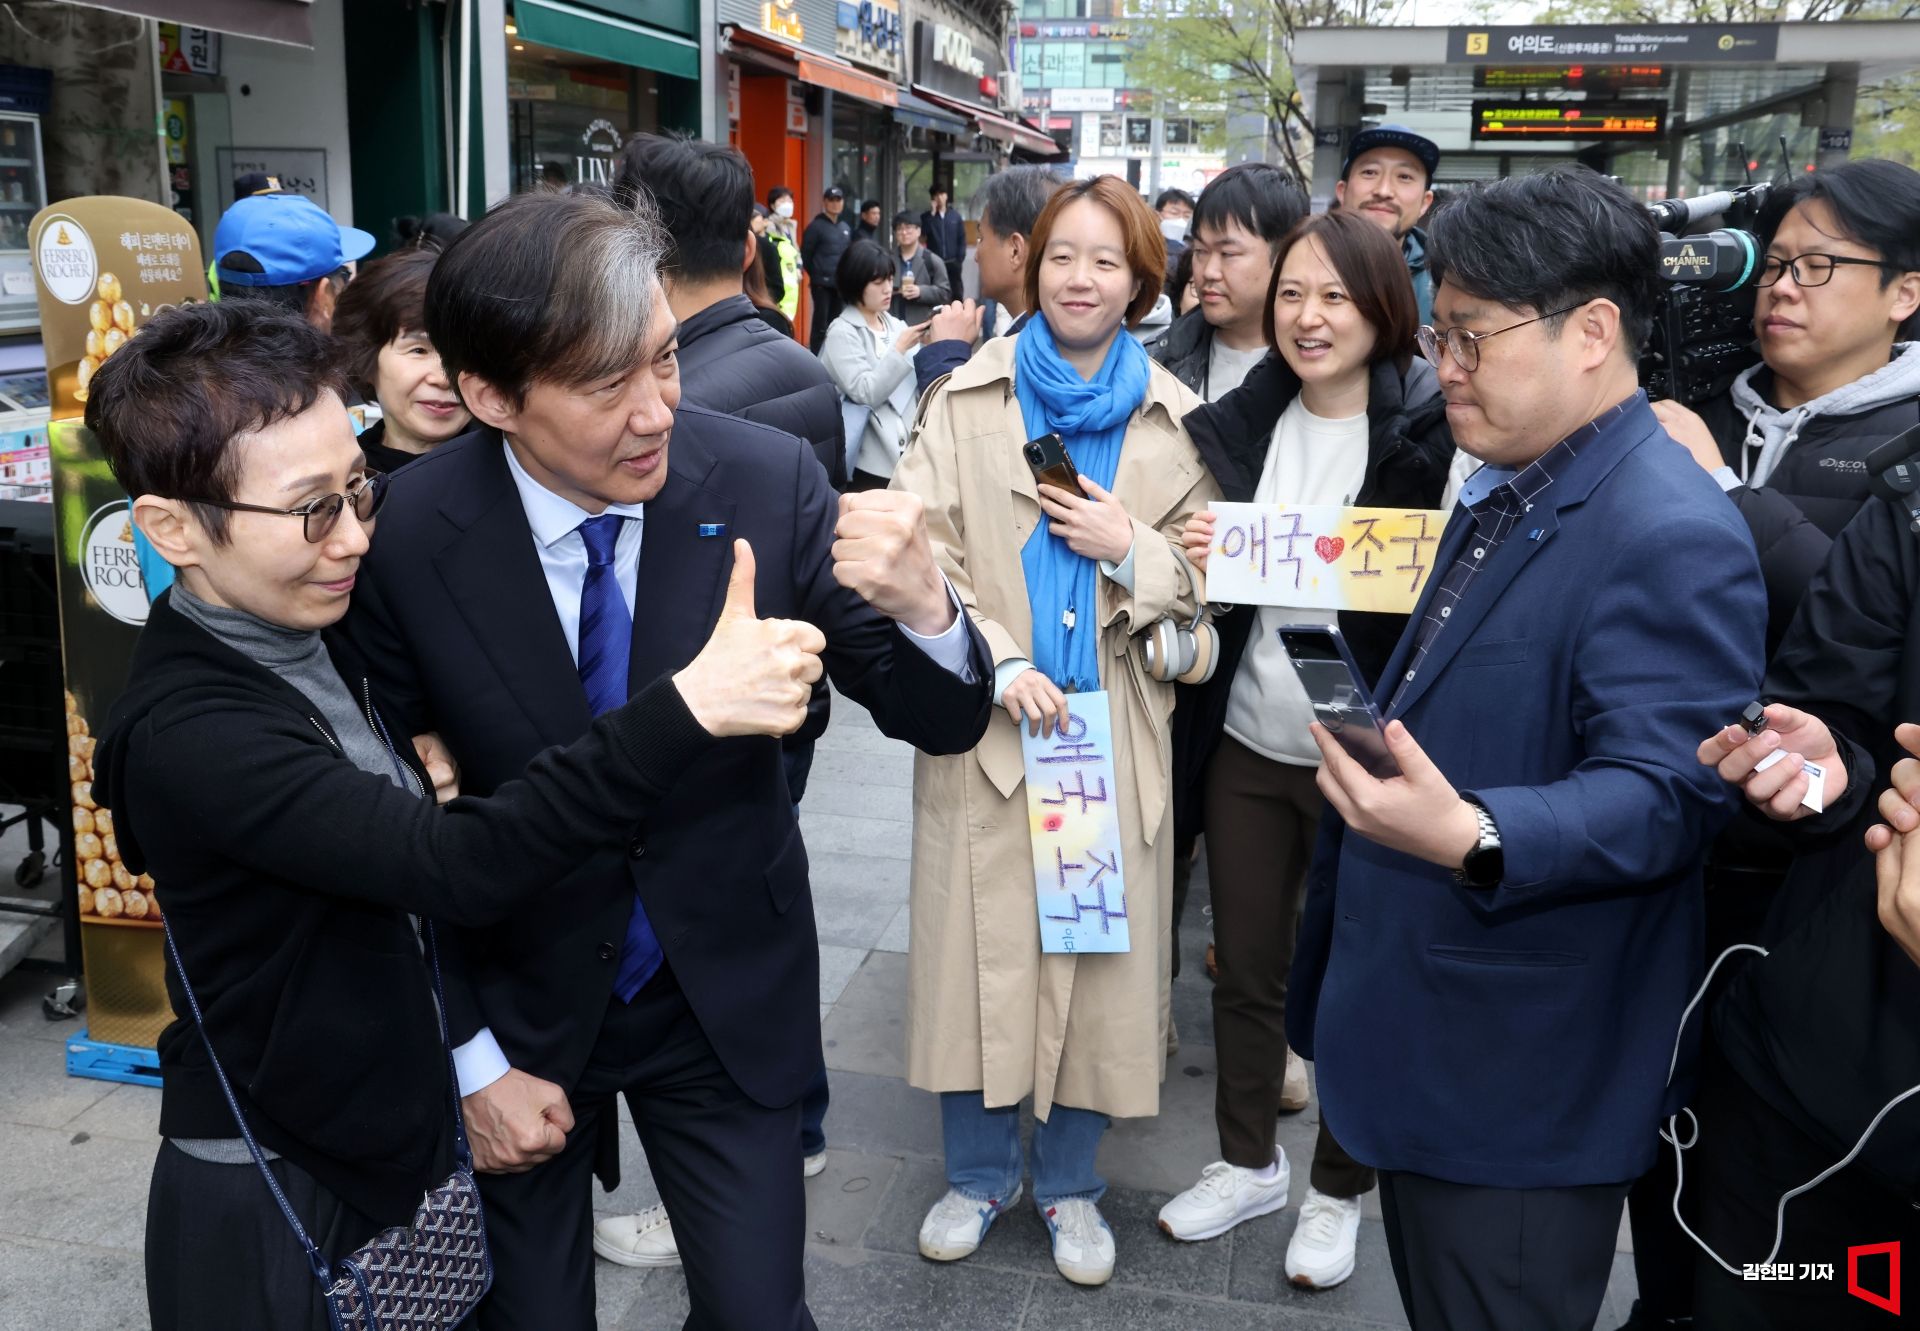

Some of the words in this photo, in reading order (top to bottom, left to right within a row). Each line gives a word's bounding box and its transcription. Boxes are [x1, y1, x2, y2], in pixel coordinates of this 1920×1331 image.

[1473, 37, 1481, 50] 5
[142, 232, 171, 251] 로맨틱
[171, 233, 192, 251] 데이
[44, 248, 88, 264] FERRERO
[1664, 256, 1711, 266] CHANNEL
[46, 263, 91, 279] ROCHER
[93, 545, 140, 568] FERR
[1222, 513, 1312, 589] 애국
[1350, 514, 1438, 593] 조국
[1036, 712, 1107, 815] 애국
[1046, 846, 1127, 935] 조국
